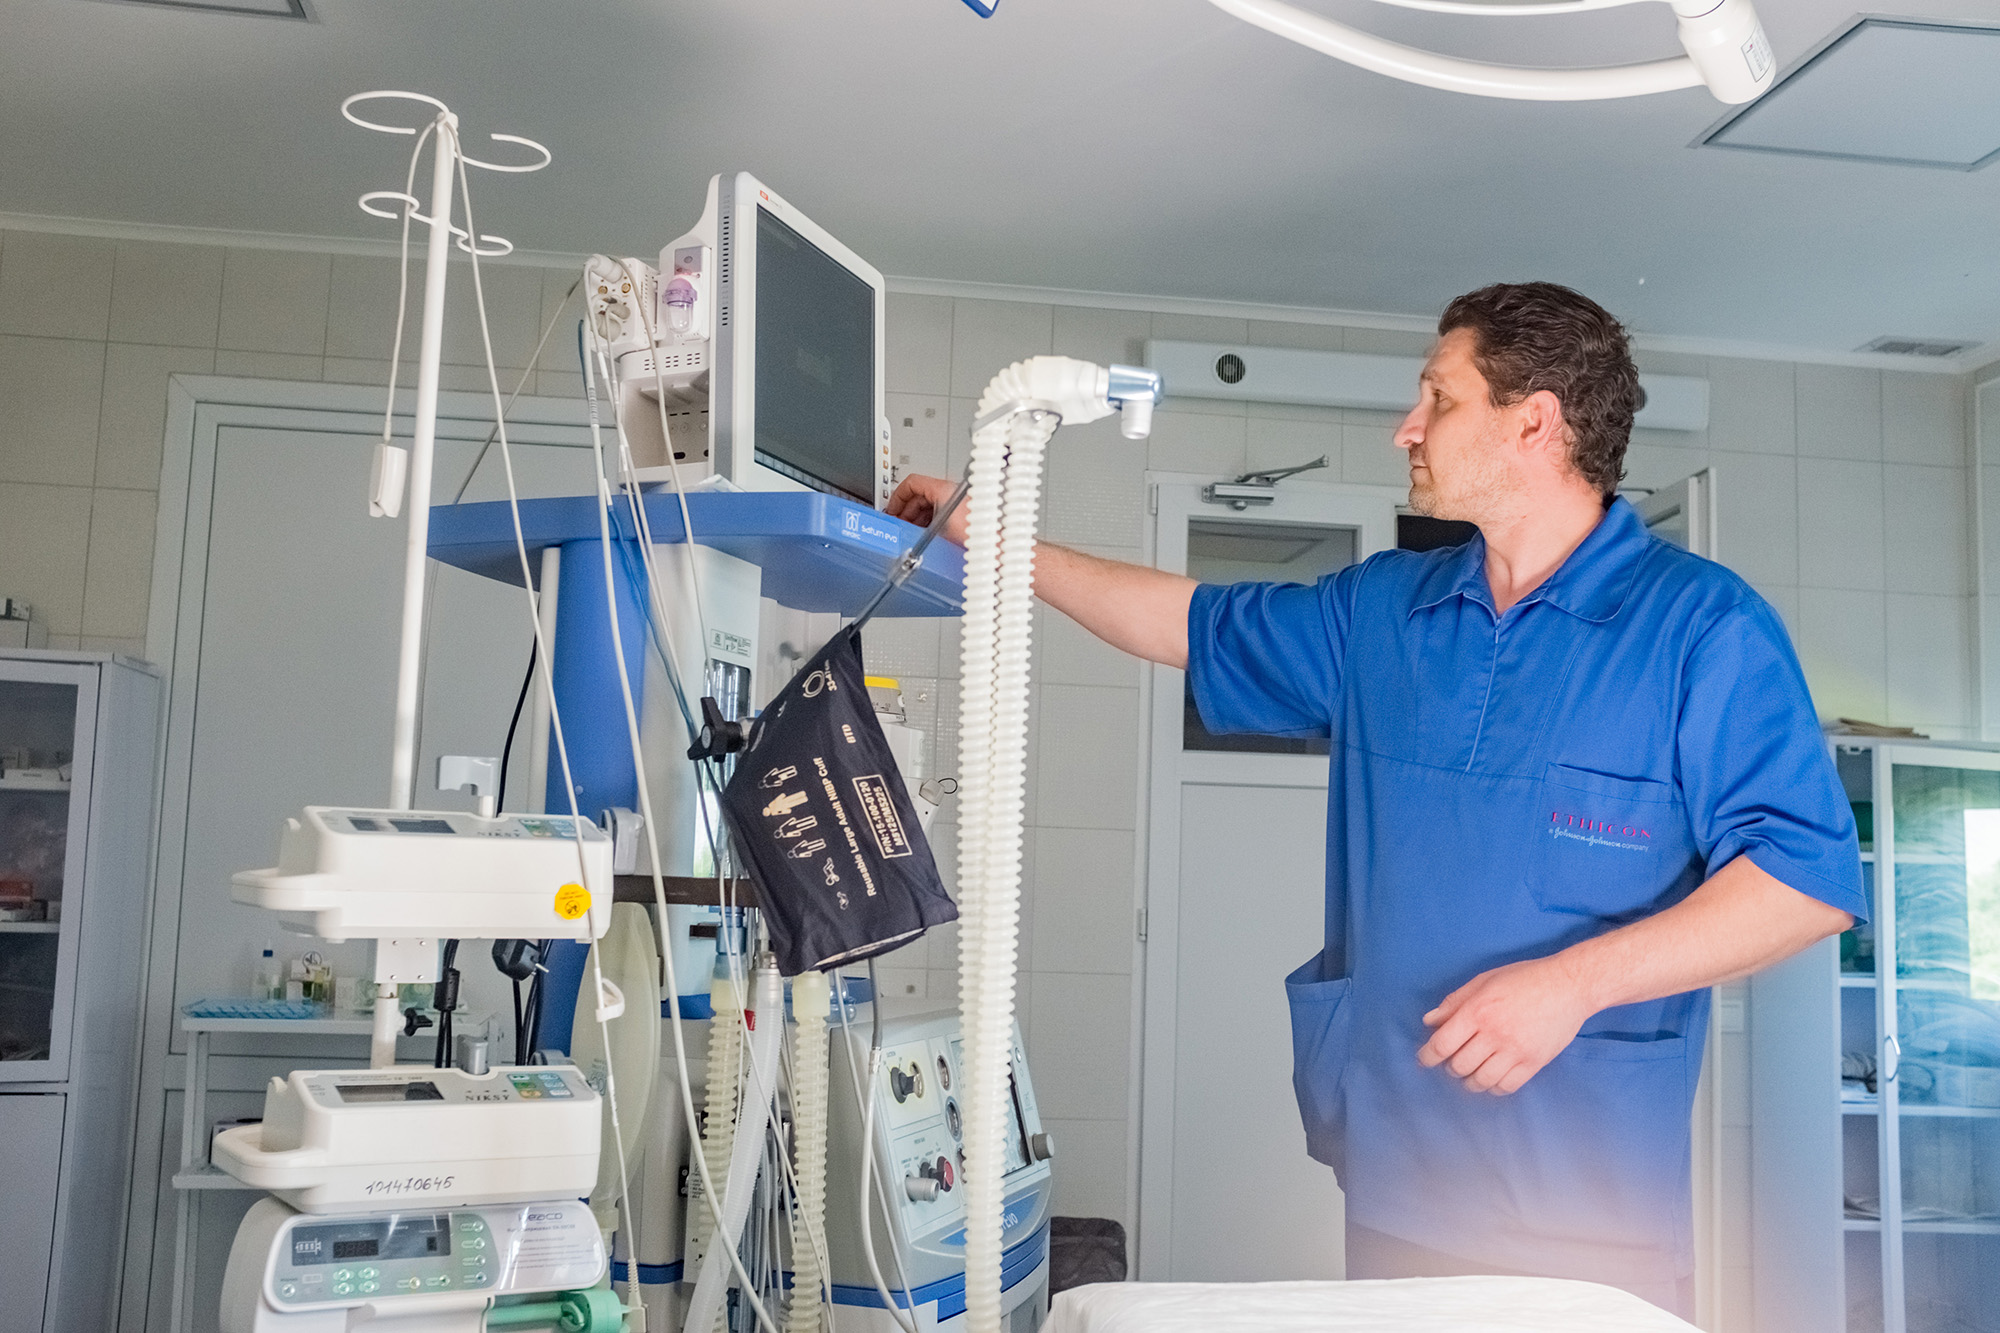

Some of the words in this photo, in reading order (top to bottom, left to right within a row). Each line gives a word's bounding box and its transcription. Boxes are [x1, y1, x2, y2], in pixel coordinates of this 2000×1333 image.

[813, 757, 828, 777] Cuff
[822, 778, 839, 802] NIBP
[832, 800, 848, 826] Adult
[1552, 812, 1651, 839] ETHICON
[843, 826, 860, 854] Large
[854, 853, 877, 897] Reusable
